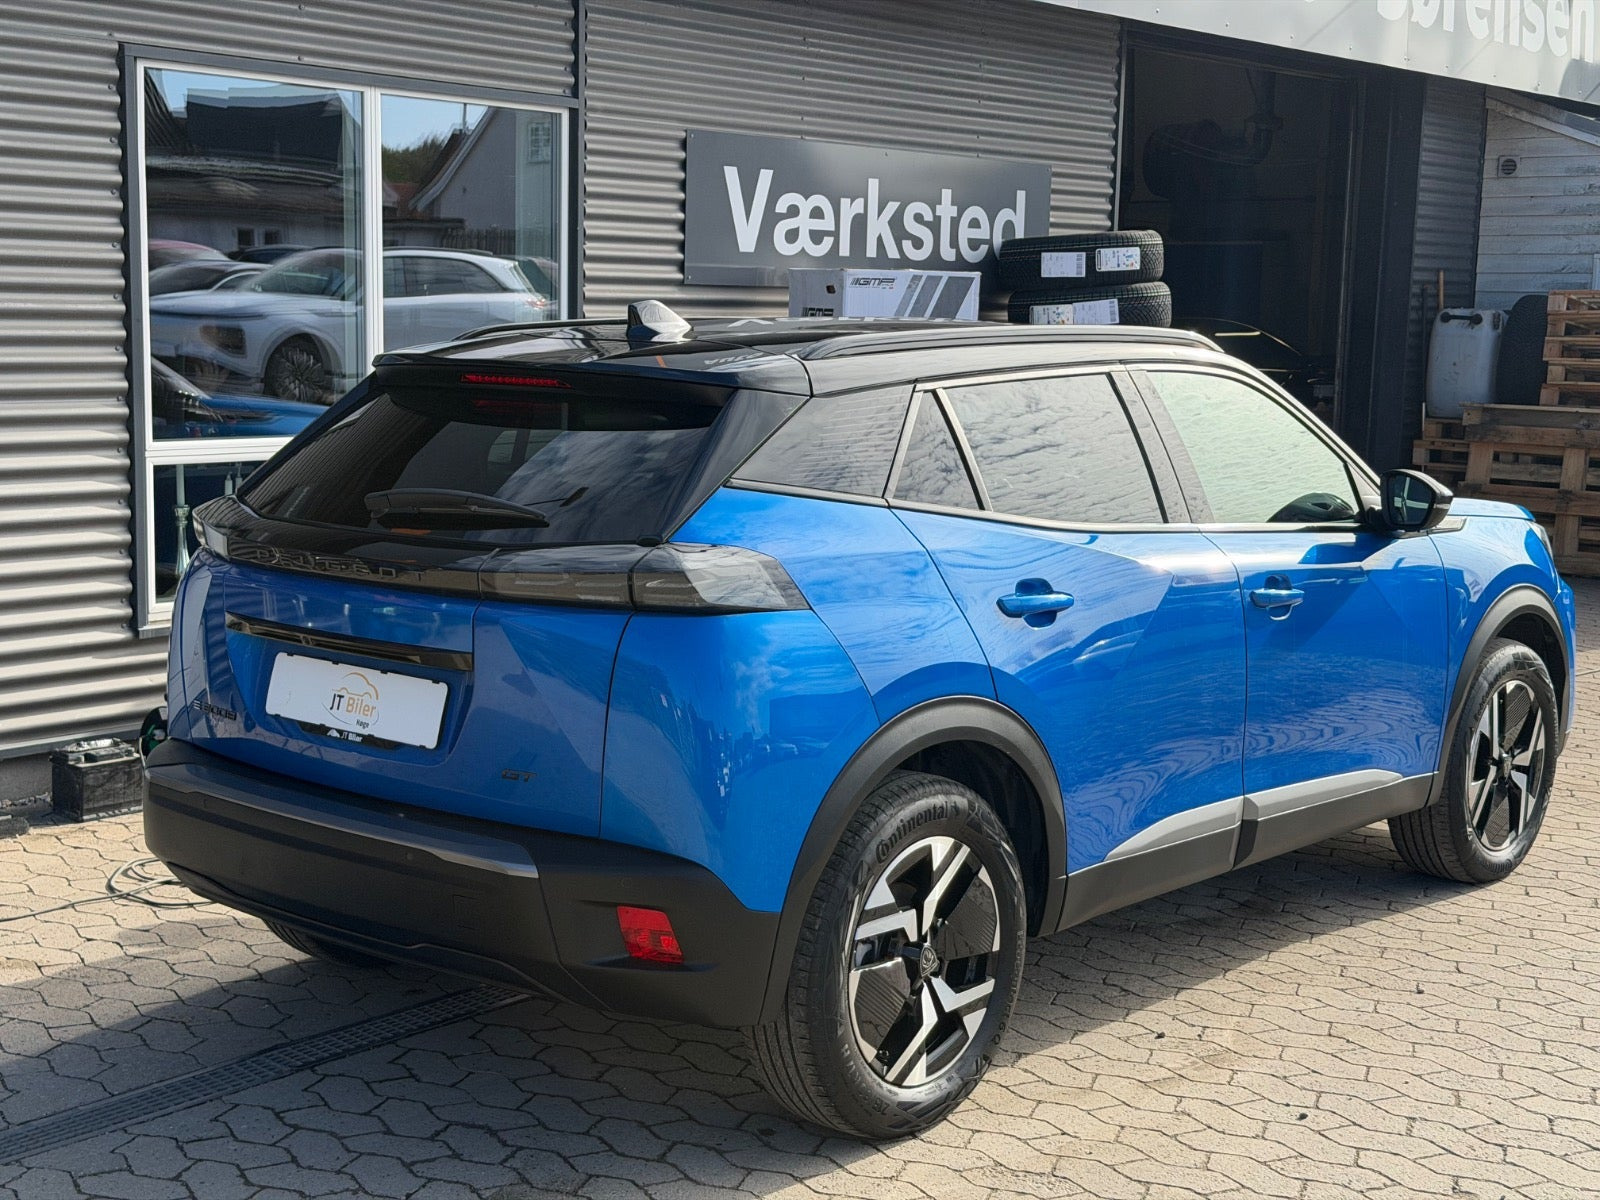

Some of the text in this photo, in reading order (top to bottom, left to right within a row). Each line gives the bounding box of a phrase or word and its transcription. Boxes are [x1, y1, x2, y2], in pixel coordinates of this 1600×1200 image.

[723, 165, 1027, 263] Værksted
[329, 693, 377, 718] JT Biler
[876, 800, 949, 864] Continental
